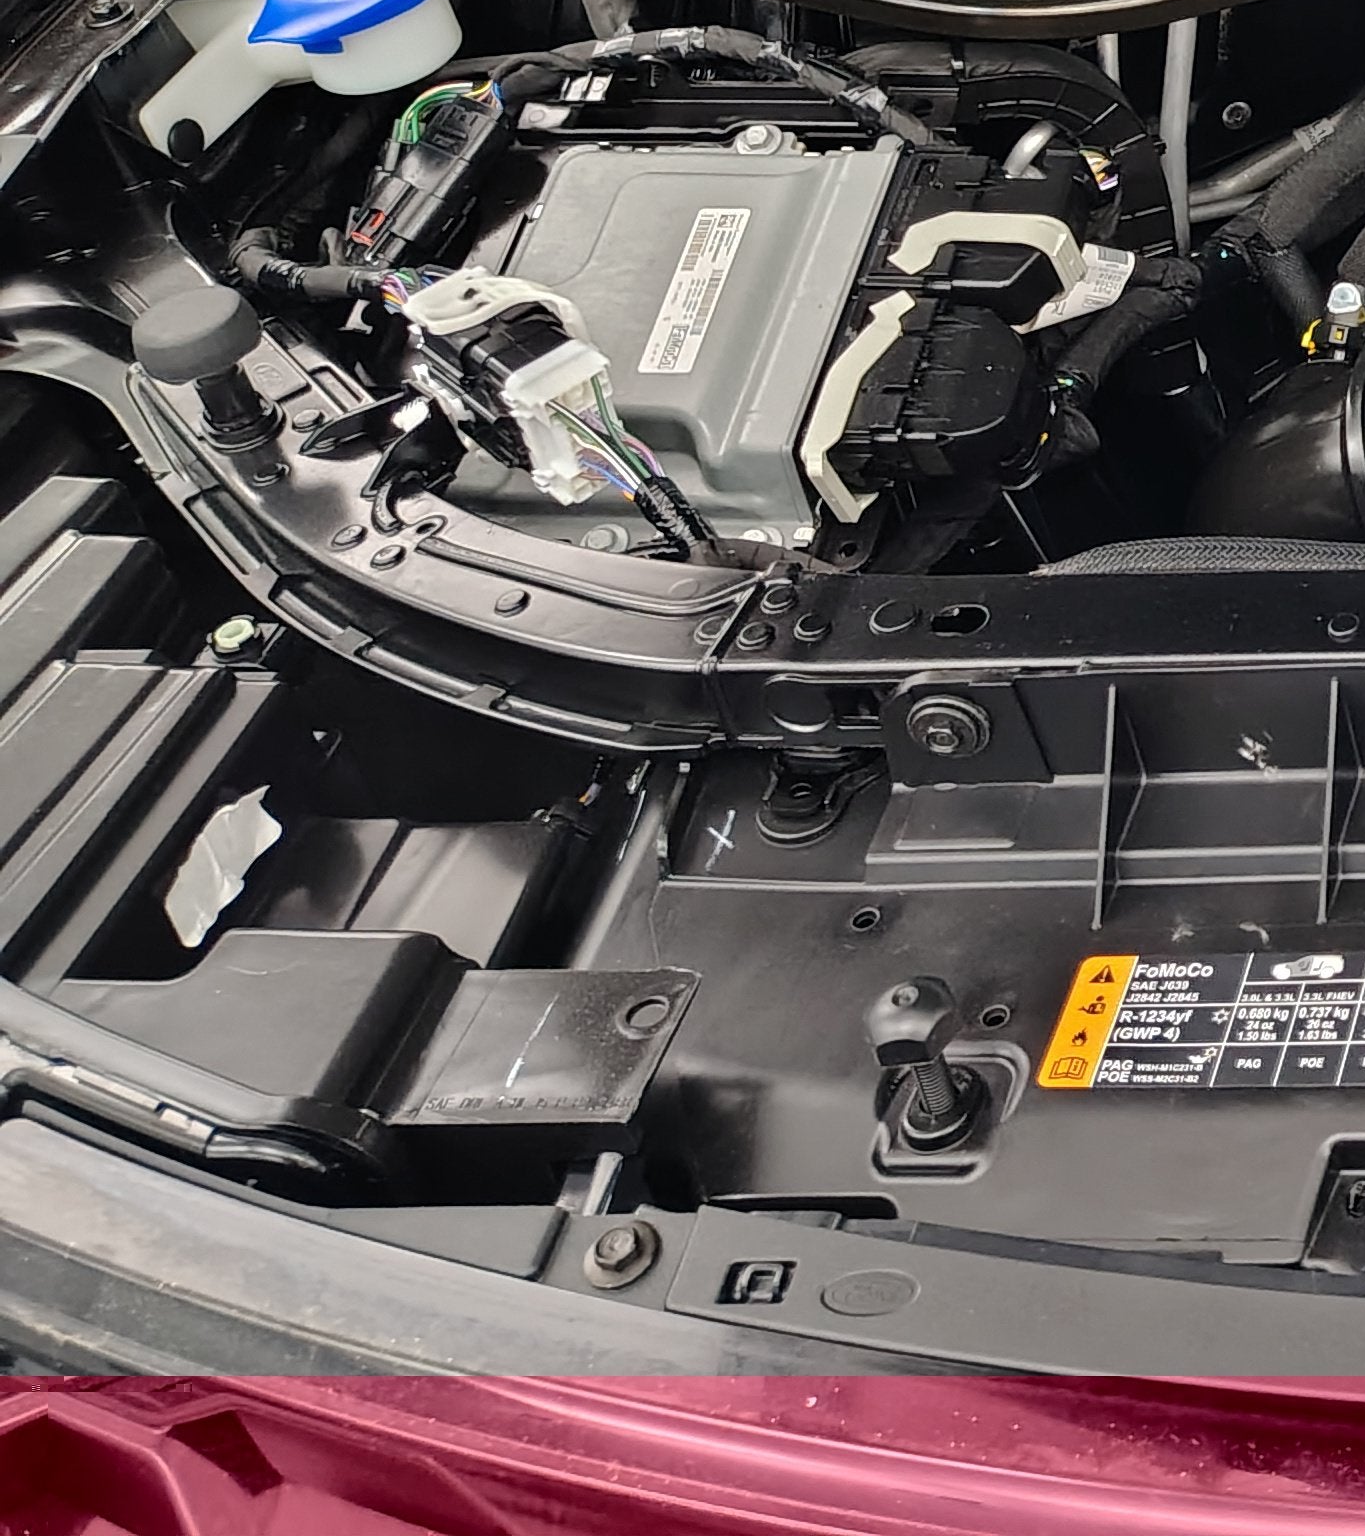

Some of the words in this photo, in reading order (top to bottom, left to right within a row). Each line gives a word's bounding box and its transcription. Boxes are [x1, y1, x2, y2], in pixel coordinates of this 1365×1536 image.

[1134, 962, 1214, 978] FoMoCo
[1130, 980, 1158, 991] SAE
[1158, 980, 1189, 991] J639
[1125, 992, 1162, 1003] J2842
[1163, 992, 1200, 1002] J2845
[1119, 1009, 1193, 1025] R-1234yf
[1273, 1007, 1290, 1021] kg
[1298, 1007, 1332, 1019] 0.737
[1333, 1006, 1350, 1020] kg
[1261, 1021, 1275, 1030] oz
[1321, 1020, 1335, 1029] oz
[1113, 1027, 1162, 1041] (GWP
[1163, 1027, 1181, 1042] 4)
[1238, 1031, 1258, 1041] 1.50
[1260, 1031, 1277, 1040] lbs
[1321, 1030, 1338, 1040] lbs
[1101, 1060, 1134, 1071] PAG
[1236, 1058, 1262, 1069] PAG
[1299, 1057, 1325, 1068] POE
[1097, 1071, 1131, 1083] POE
